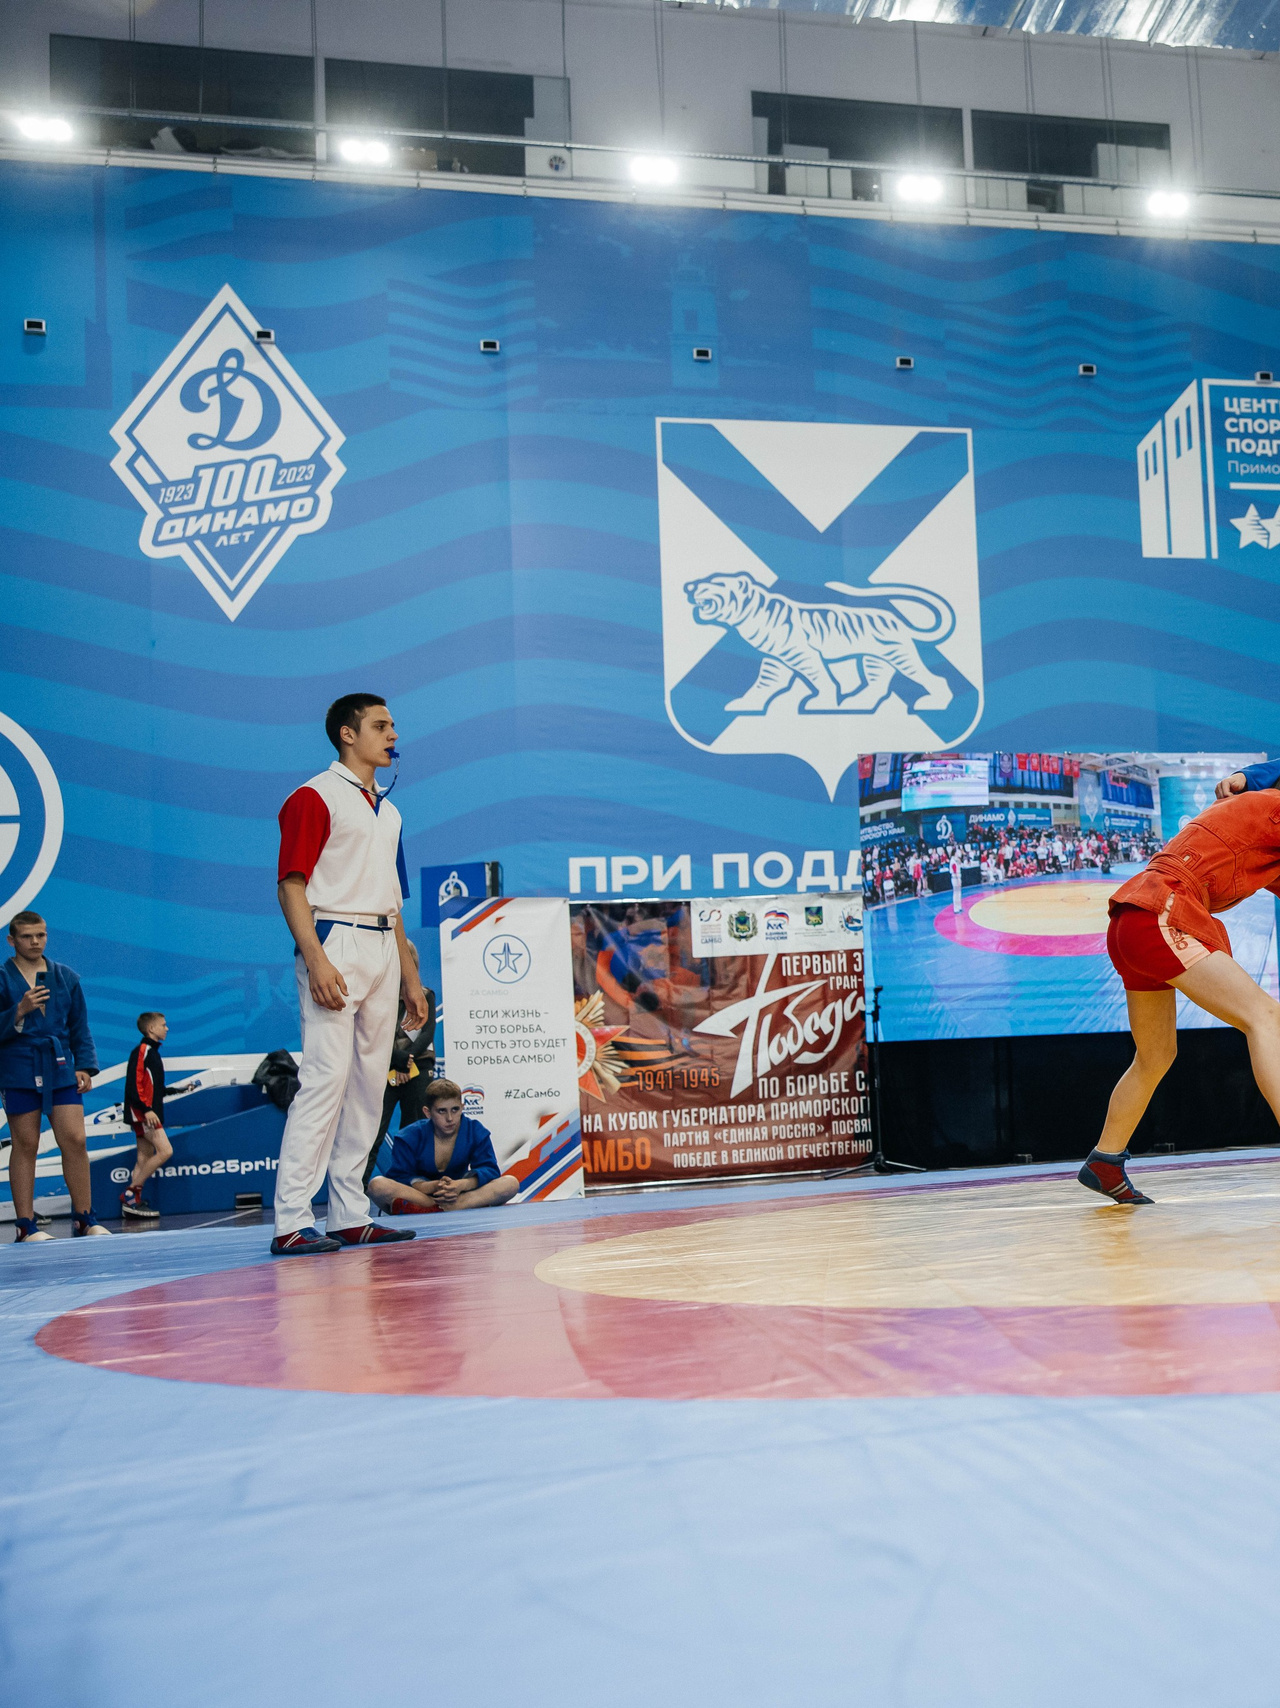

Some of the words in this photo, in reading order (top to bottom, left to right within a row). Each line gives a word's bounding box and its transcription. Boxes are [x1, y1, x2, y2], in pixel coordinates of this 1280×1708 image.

[158, 483, 195, 504] 1923
[197, 457, 279, 511] 100
[277, 463, 316, 486] 2023
[157, 496, 315, 543] ДИНАМО
[214, 530, 255, 548] ЛЕТ
[968, 813, 1006, 823] ДИНАМО
[568, 854, 692, 894] ПРИ
[781, 950, 848, 977] ПЕРВЫЙ
[853, 951, 864, 973] Э
[830, 974, 865, 991] ГРАН-
[469, 1009, 499, 1020] ЕСЛИ
[501, 1009, 541, 1019] ЖИЗНЬ
[475, 1025, 498, 1035] ЭТО
[500, 1024, 546, 1034] БОРЬБА,
[454, 1041, 469, 1050] ТО
[471, 1040, 507, 1050] ПУСТЬ
[509, 1039, 532, 1049] ЭТО
[533, 1038, 567, 1050] БУДЕТ
[467, 1055, 511, 1066] БОРЬБА
[512, 1053, 556, 1065] САМБО!
[635, 1067, 721, 1093] 1941-1945
[758, 1077, 780, 1099] ПО
[785, 1071, 850, 1098] БОРЬБЕ
[855, 1070, 870, 1092] С
[583, 1114, 604, 1134] НА
[608, 1110, 659, 1132] КУБОК
[662, 1103, 767, 1129] ГУБЕРНАТОРА
[770, 1096, 870, 1120] ПРИМОРСКОГ
[663, 1129, 710, 1148] ПАРТИЯ
[713, 1125, 769, 1145] «ЕДИНАЯ
[771, 1121, 829, 1141] РОССИЯ»,
[673, 1151, 718, 1169] ПОБЕДЕ
[721, 1149, 729, 1165] В
[732, 1142, 785, 1164] ВЕЛИКОЙ
